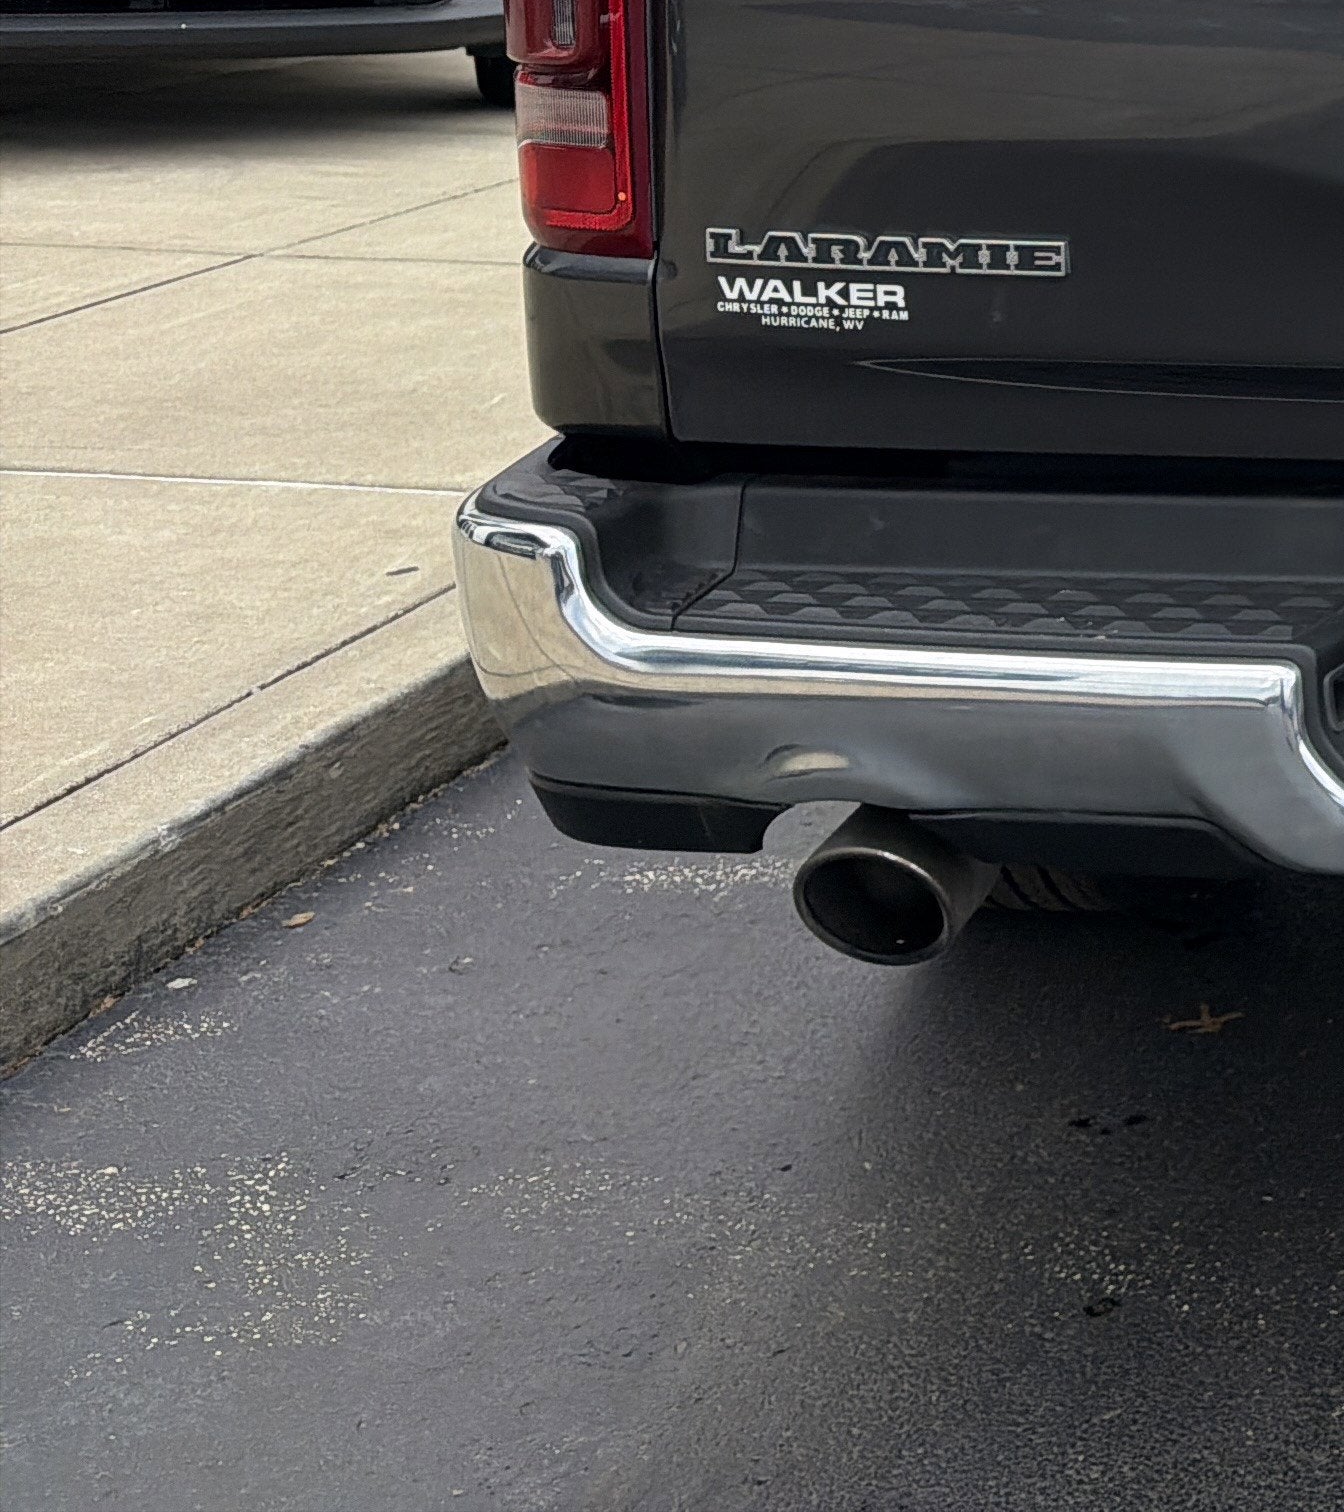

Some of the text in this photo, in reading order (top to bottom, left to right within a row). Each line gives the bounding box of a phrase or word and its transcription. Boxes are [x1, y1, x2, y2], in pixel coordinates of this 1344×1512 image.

[706, 227, 1069, 277] LARAMIE
[717, 276, 906, 308] WALKER
[717, 301, 909, 321] CHRYSLER DODGE JEEP RAM
[761, 316, 864, 332] HURRICANE, WV
